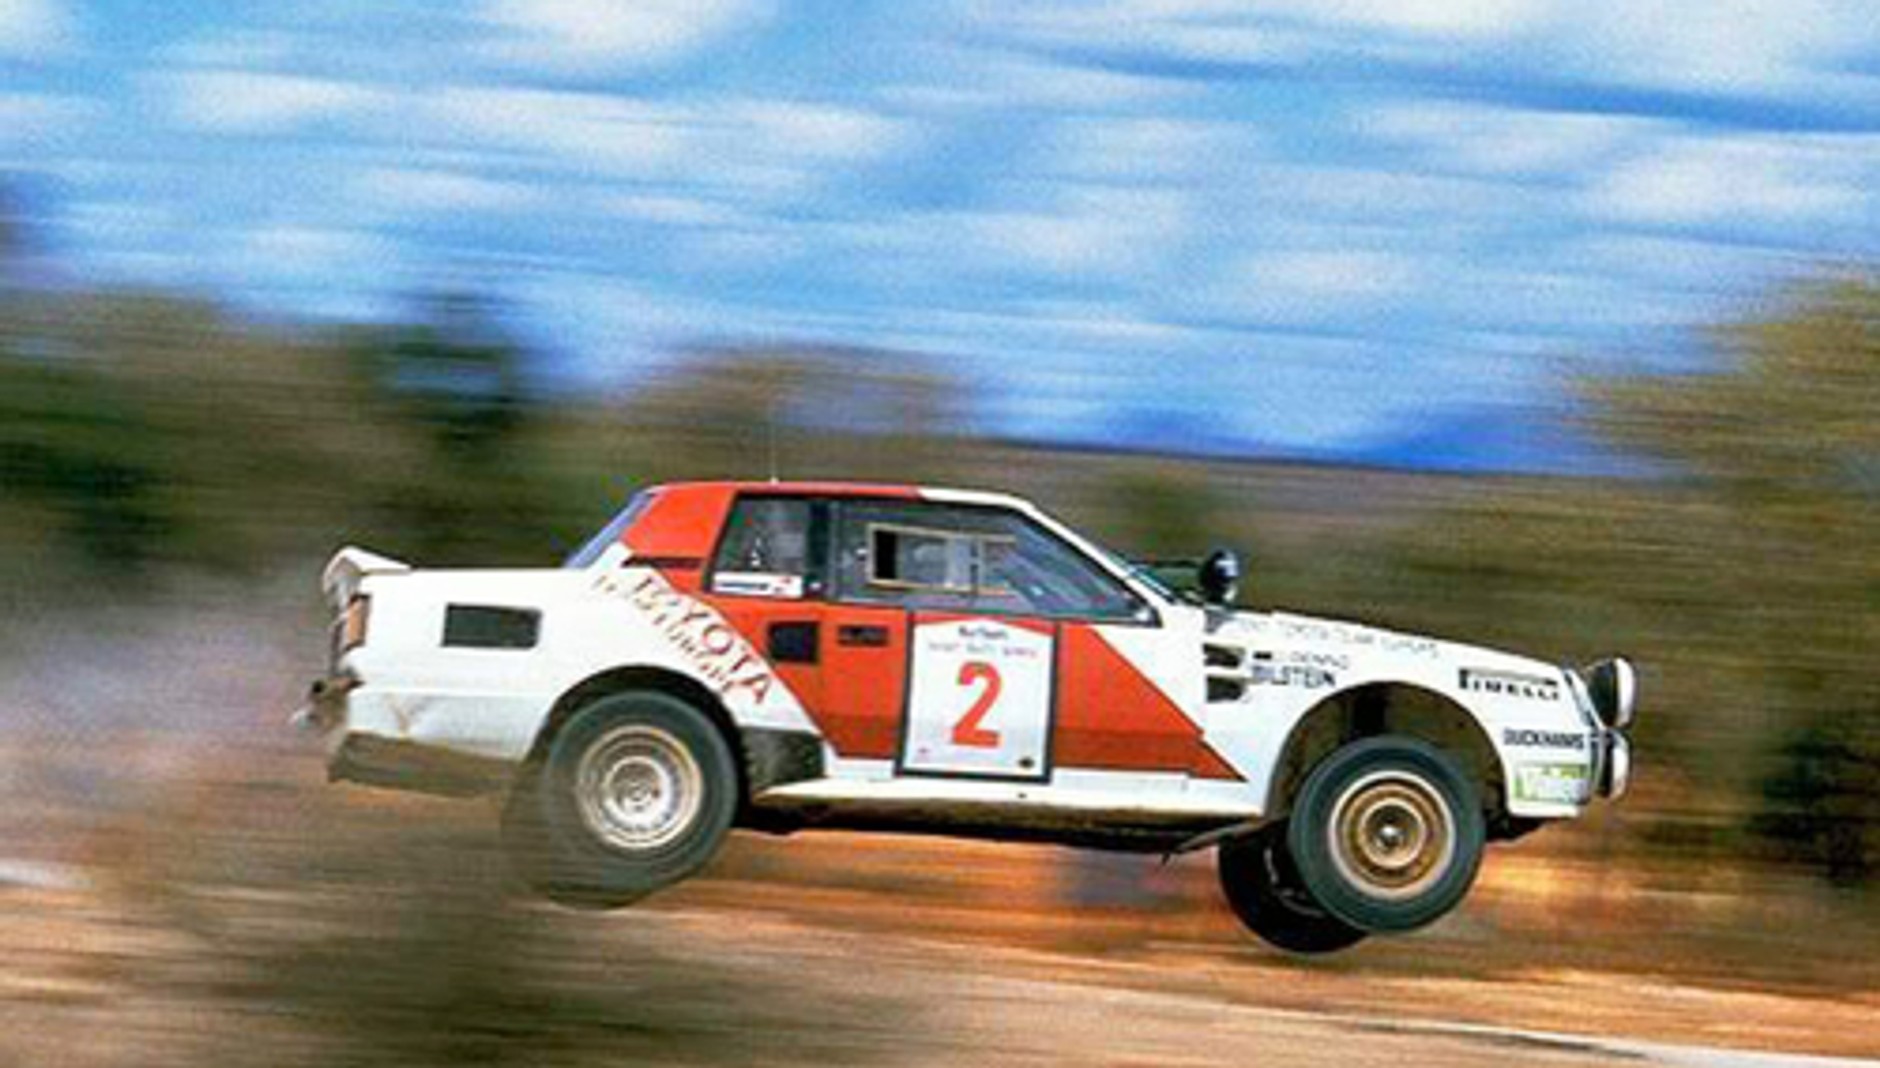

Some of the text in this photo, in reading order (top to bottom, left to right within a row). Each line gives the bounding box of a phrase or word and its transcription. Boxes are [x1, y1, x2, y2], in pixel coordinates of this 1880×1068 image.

[632, 572, 772, 705] TOYOTA
[952, 660, 1003, 748] 2
[1458, 667, 1560, 701] PIRELLI
